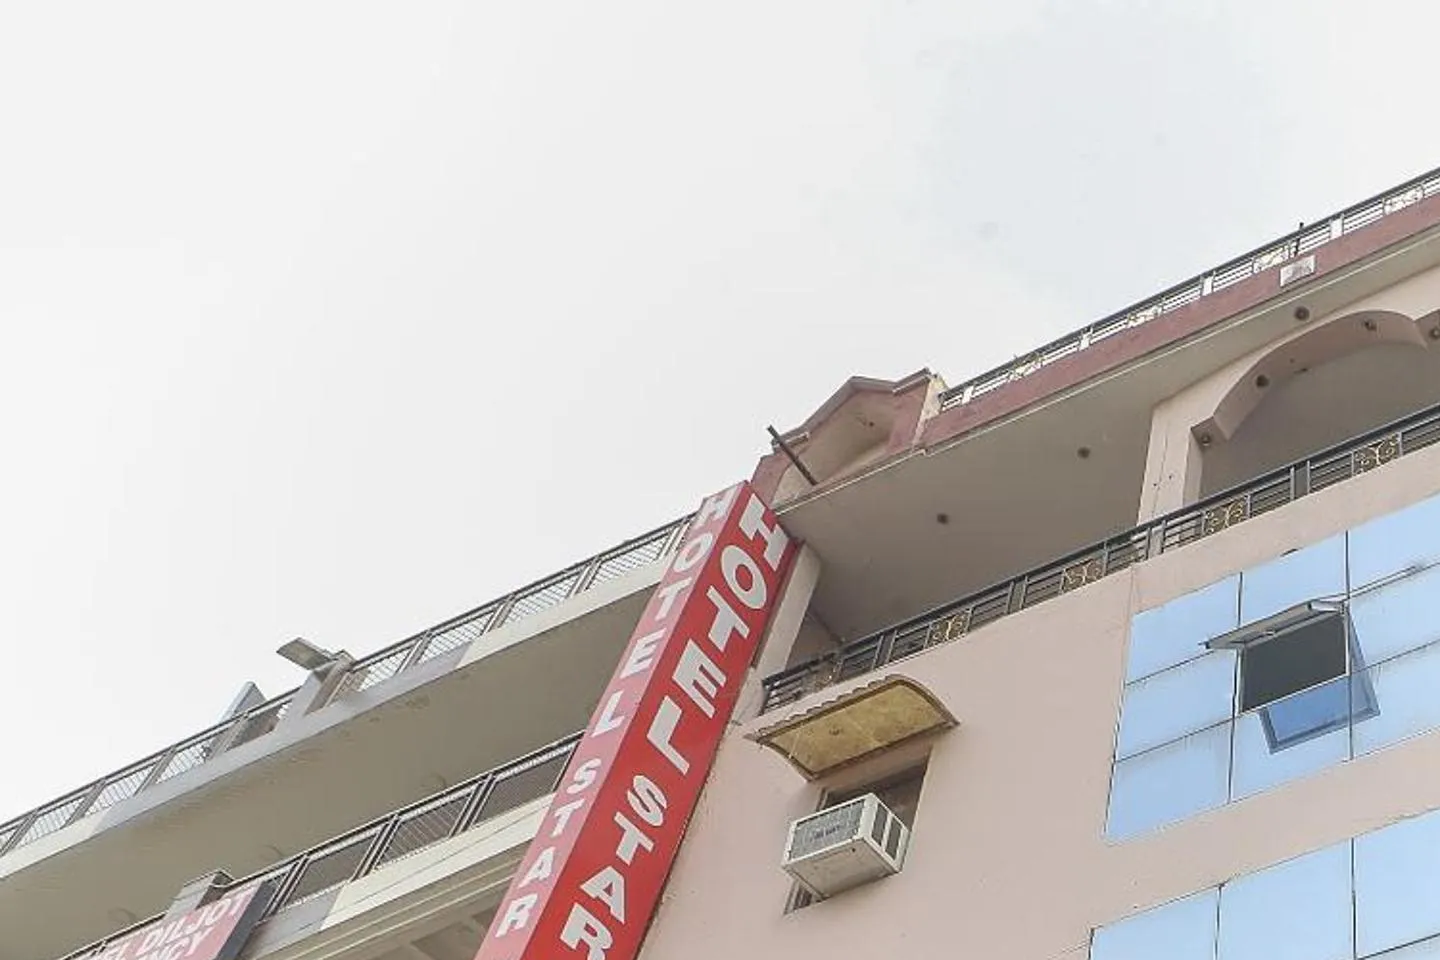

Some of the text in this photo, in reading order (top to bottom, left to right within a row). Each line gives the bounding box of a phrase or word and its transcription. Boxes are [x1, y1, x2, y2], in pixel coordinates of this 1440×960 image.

[592, 483, 738, 737] HOTEL
[647, 493, 789, 776] HOTEL
[495, 757, 601, 938] STAR
